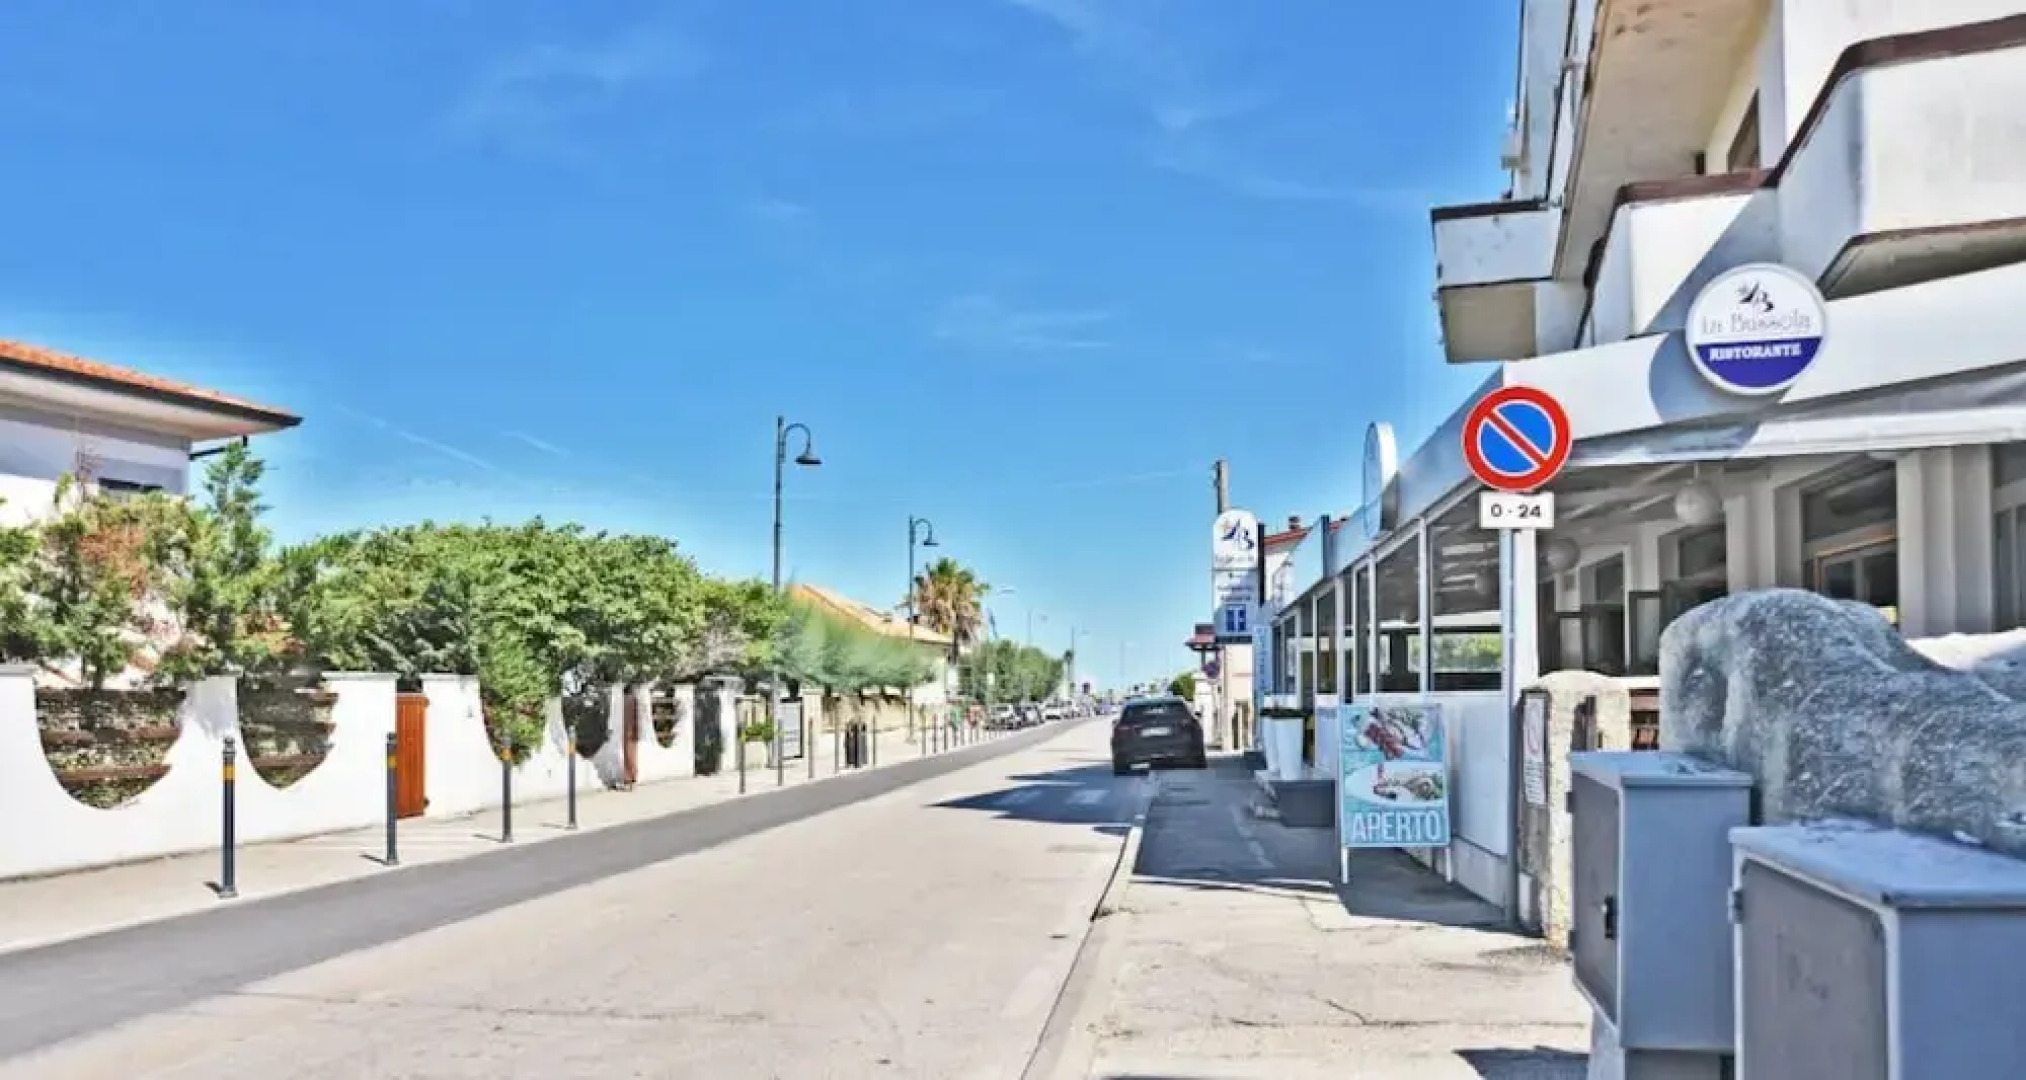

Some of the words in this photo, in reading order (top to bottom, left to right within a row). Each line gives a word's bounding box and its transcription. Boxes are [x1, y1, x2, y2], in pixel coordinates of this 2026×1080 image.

[1709, 344, 1800, 361] RISTORANTE
[1490, 504, 1502, 518] 0
[1518, 504, 1541, 519] 24
[1352, 811, 1441, 841] APERTO
